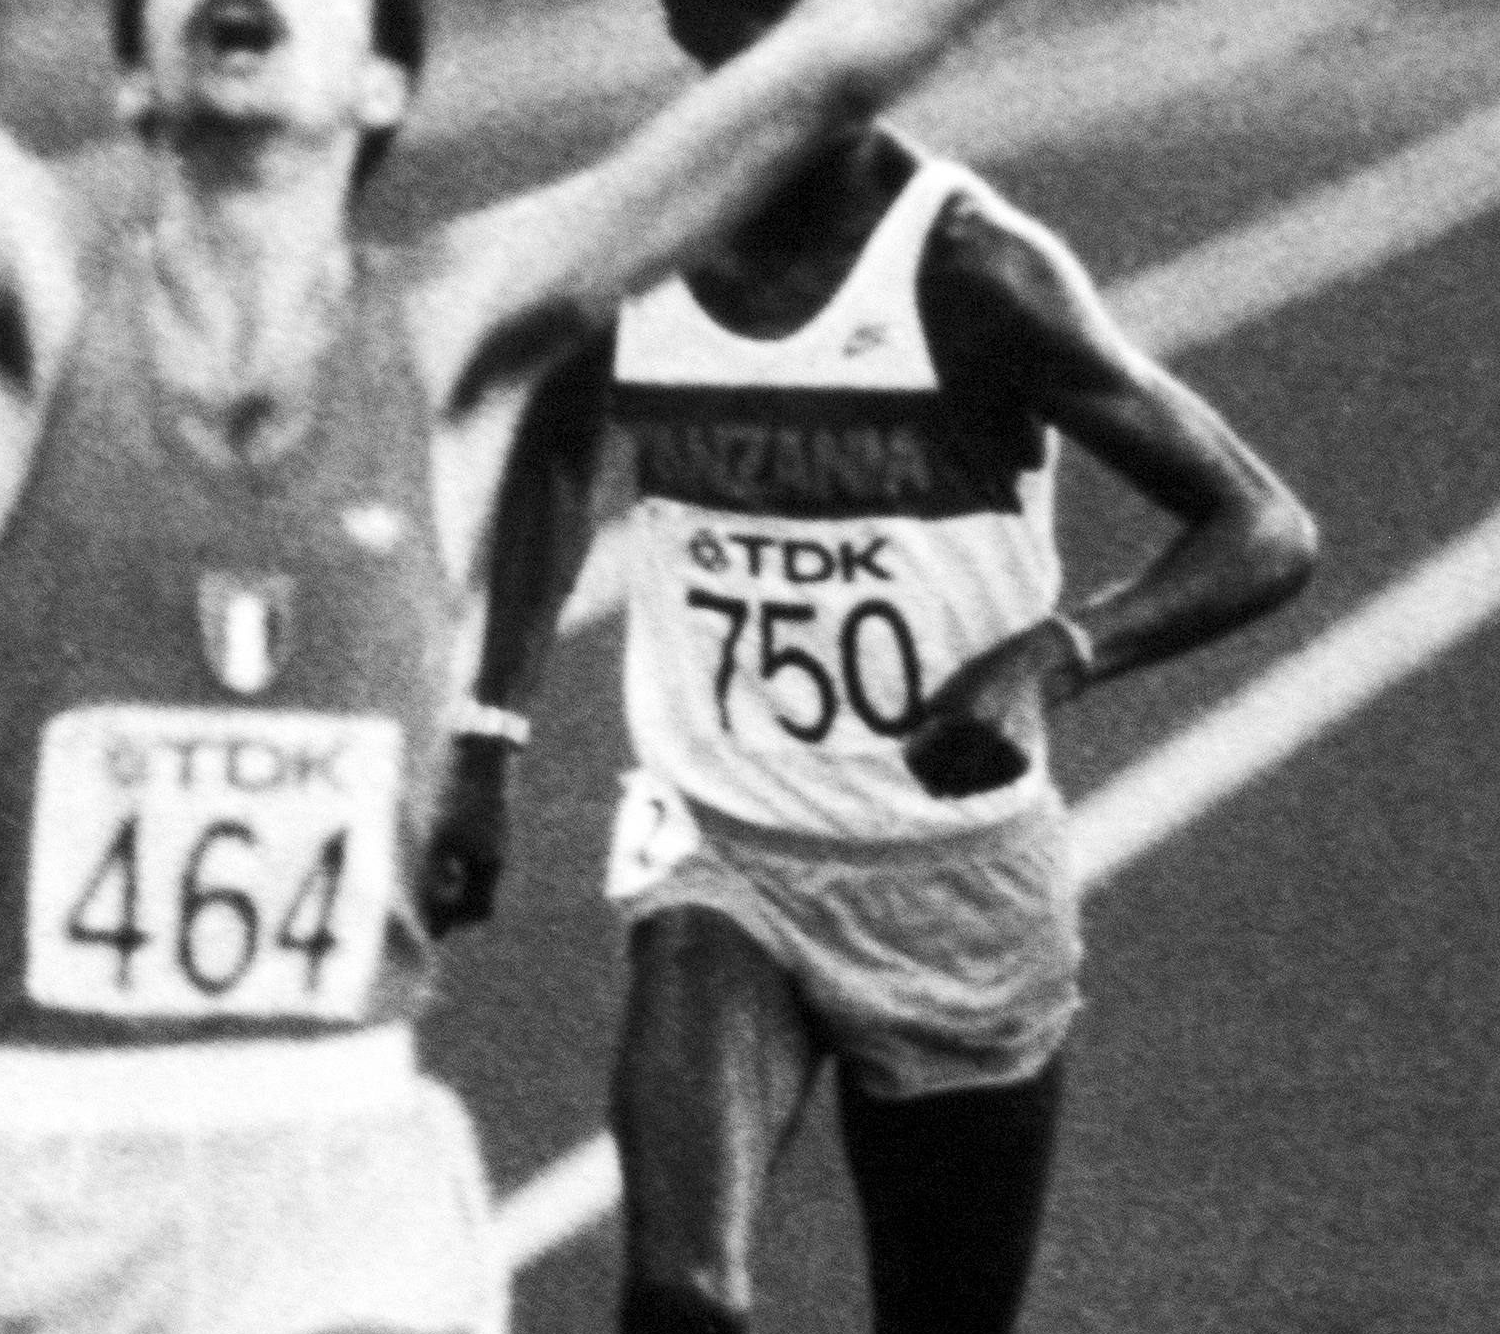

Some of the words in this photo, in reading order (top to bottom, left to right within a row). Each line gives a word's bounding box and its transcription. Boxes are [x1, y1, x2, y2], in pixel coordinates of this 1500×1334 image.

[728, 532, 895, 584] TDK
[686, 589, 922, 744] 750
[160, 735, 350, 793] TDK
[62, 812, 349, 995] 464
